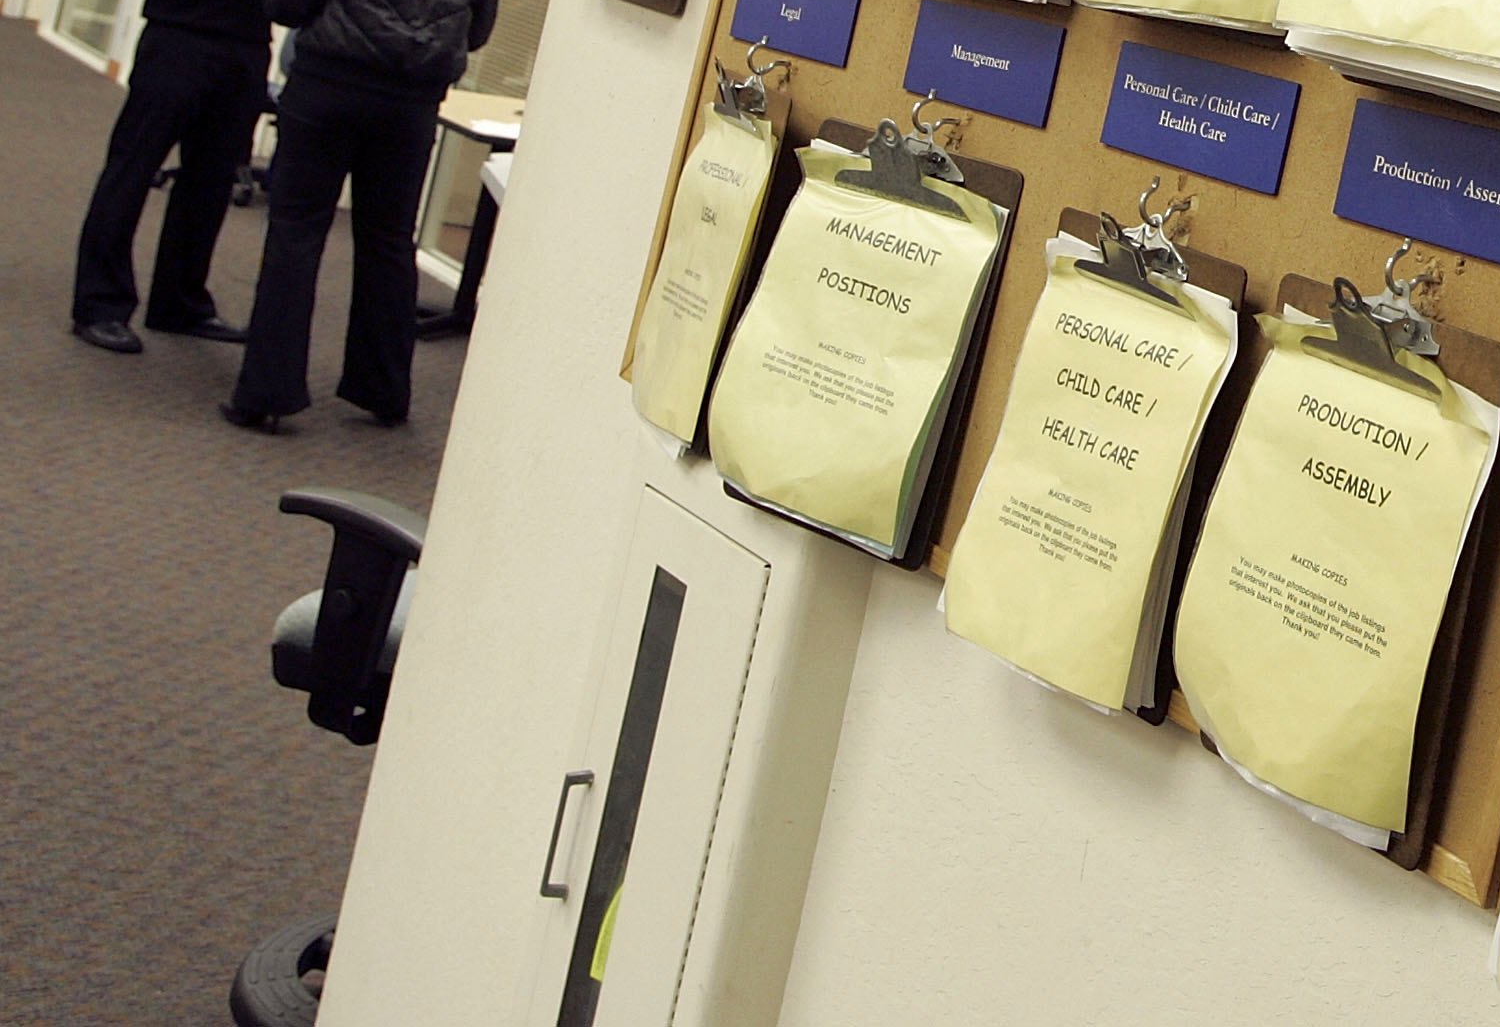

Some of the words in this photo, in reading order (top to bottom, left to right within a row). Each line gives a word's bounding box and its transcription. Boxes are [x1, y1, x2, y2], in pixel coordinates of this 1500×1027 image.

[950, 43, 1010, 70] Management
[1123, 73, 1170, 99] Personal
[1172, 86, 1198, 106] Care
[1199, 93, 1207, 108] /
[1207, 95, 1241, 118] Child
[1242, 104, 1270, 126] Care
[1271, 112, 1280, 130] /
[1158, 109, 1196, 134] Health
[1199, 121, 1226, 142] Care
[1372, 154, 1450, 190] Production
[825, 217, 942, 266] MANAGEMENT
[817, 267, 911, 314] POSITIONS
[1055, 312, 1129, 353] PERSONAL
[1134, 340, 1178, 368] CARE
[1177, 354, 1193, 371] /
[1056, 368, 1100, 398] CHILD
[1104, 385, 1144, 414] CARE
[1145, 398, 1157, 417] /
[1041, 416, 1096, 455] HEALTH
[1098, 437, 1140, 470] CARE
[1297, 394, 1411, 455] PRODUCTION
[1415, 442, 1429, 460] /
[1301, 457, 1391, 507] ASSEMBLY
